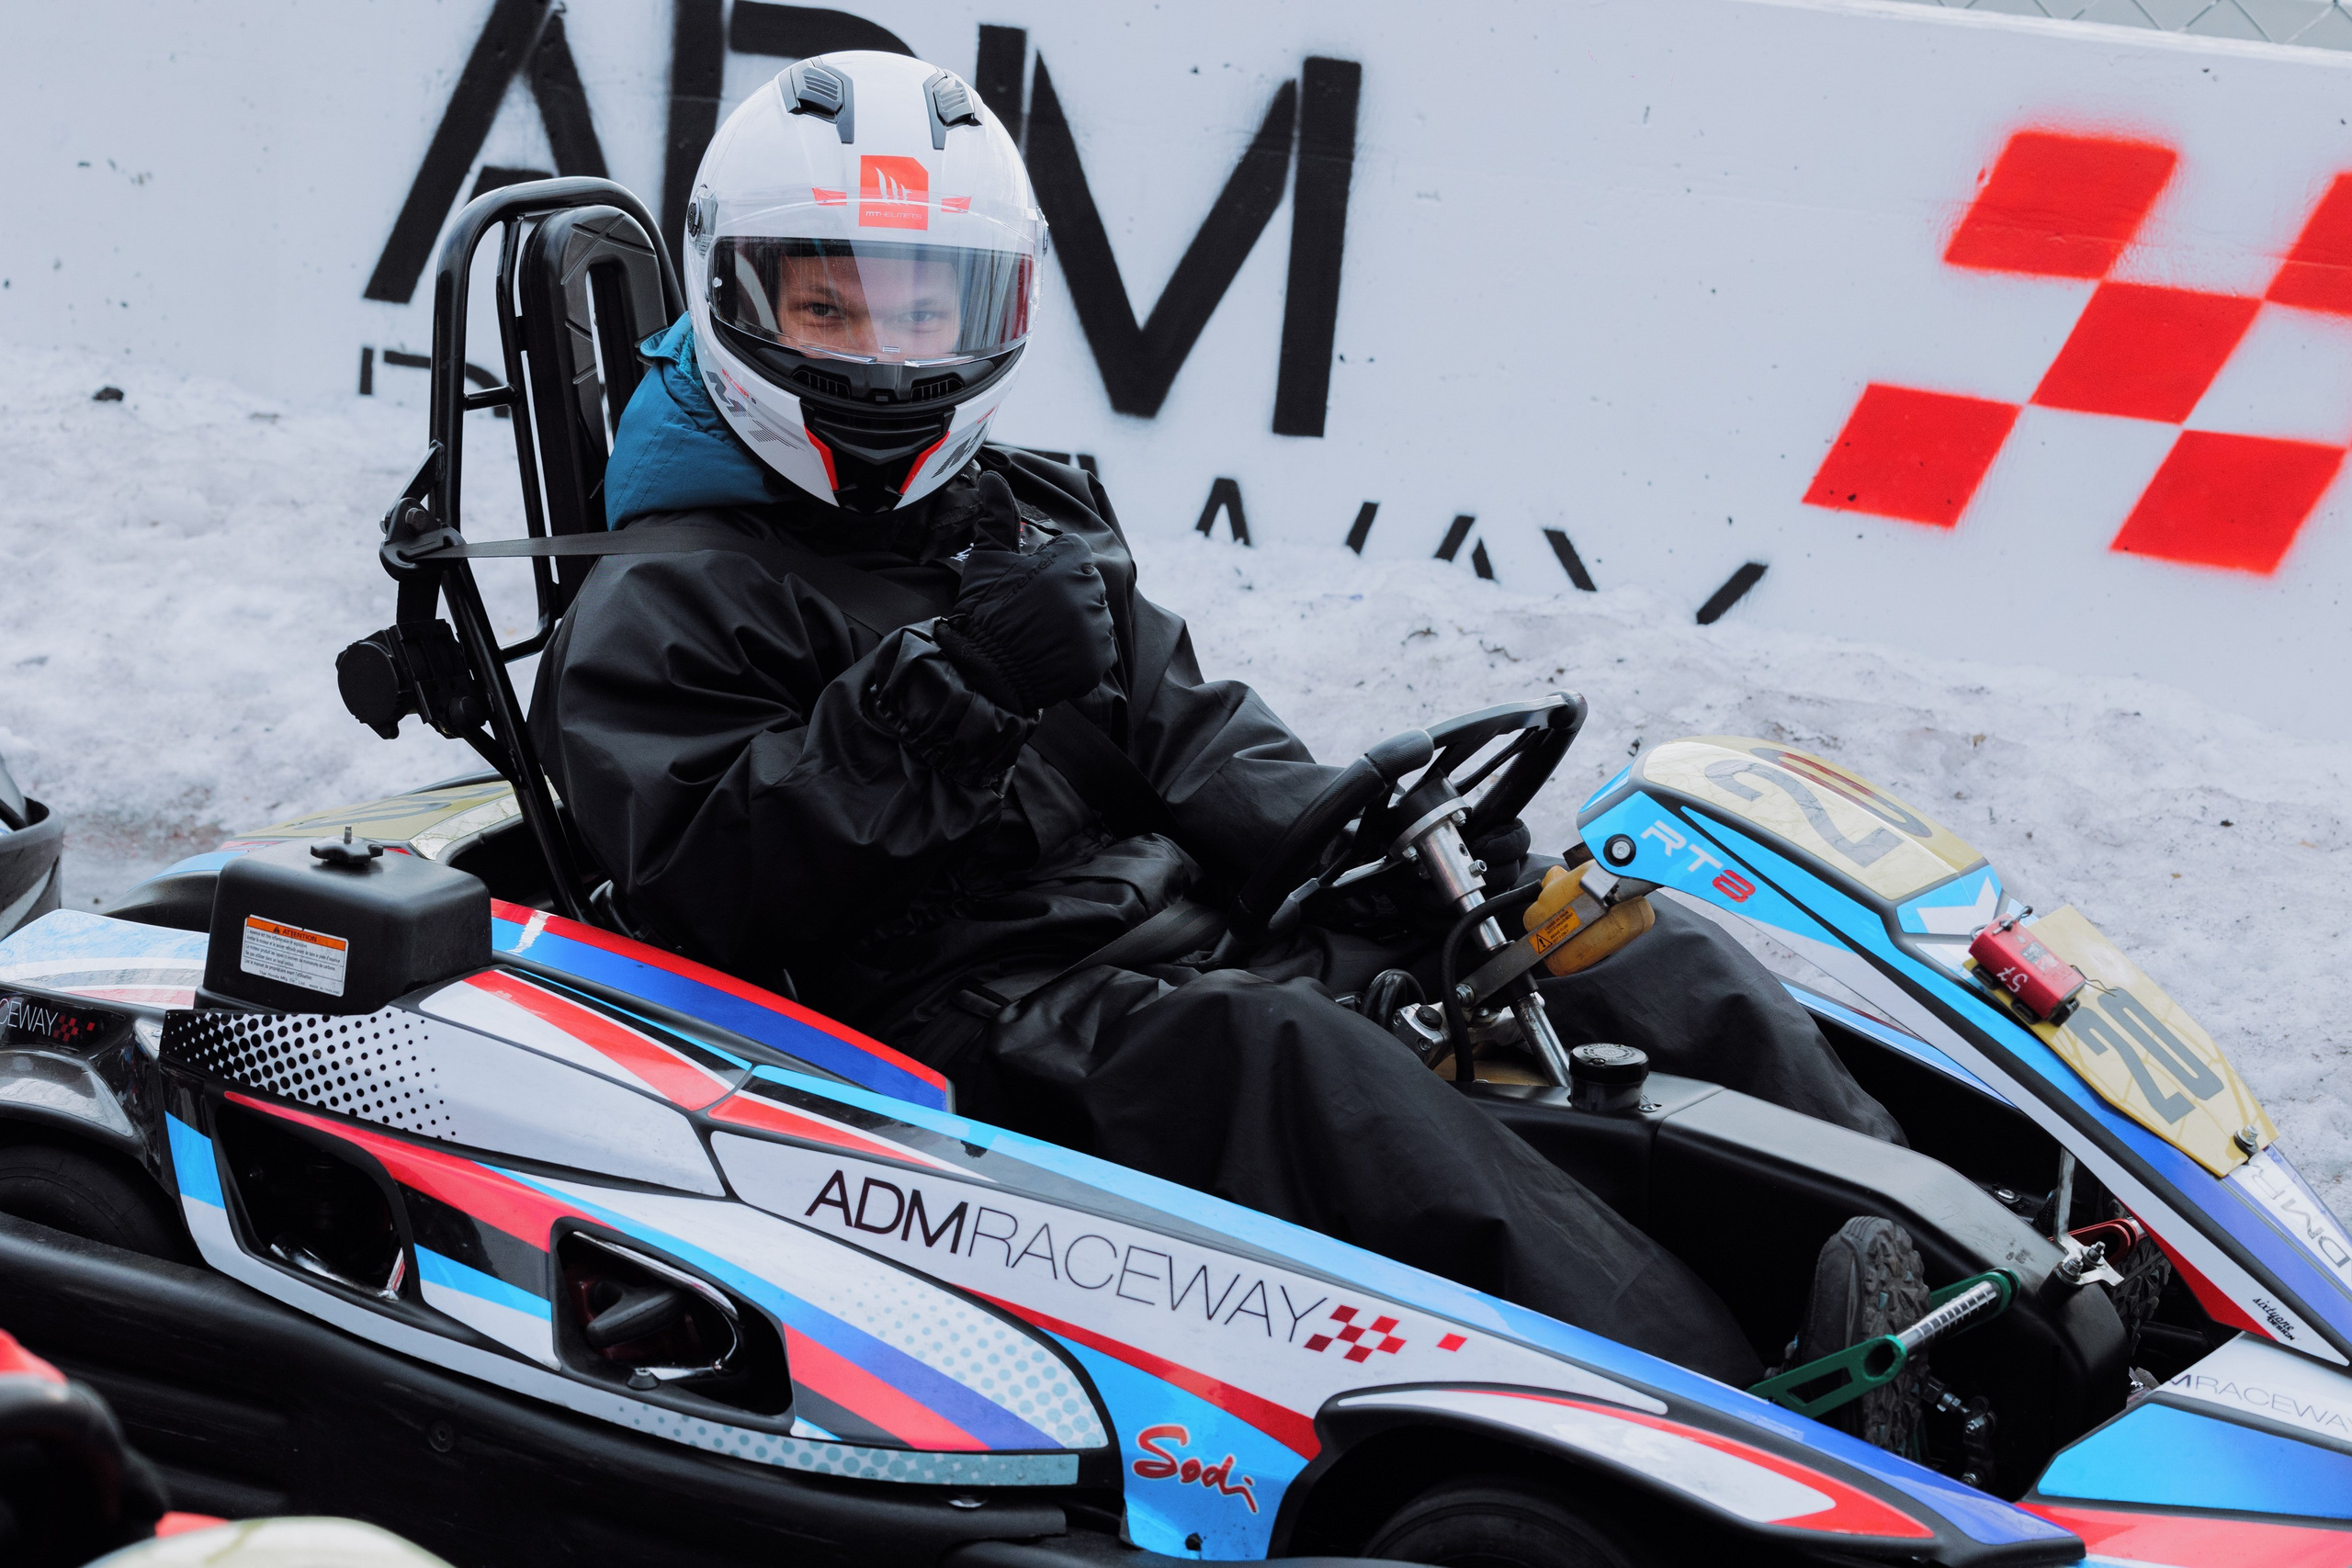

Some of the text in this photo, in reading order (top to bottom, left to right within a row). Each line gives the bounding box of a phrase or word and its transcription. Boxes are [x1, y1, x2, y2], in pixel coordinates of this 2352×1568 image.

[1704, 748, 1933, 868] 20
[1639, 819, 1757, 903] RT8
[282, 929, 317, 942] ATTENTION
[1996, 966, 2029, 993] 57
[2064, 987, 2225, 1125] 20
[805, 1169, 1329, 1344] ADMRACEWAY
[2267, 1314, 2296, 1341] DESIGN
[2170, 1374, 2352, 1434] MRACEWA
[1132, 1425, 1258, 1514] Sodi
